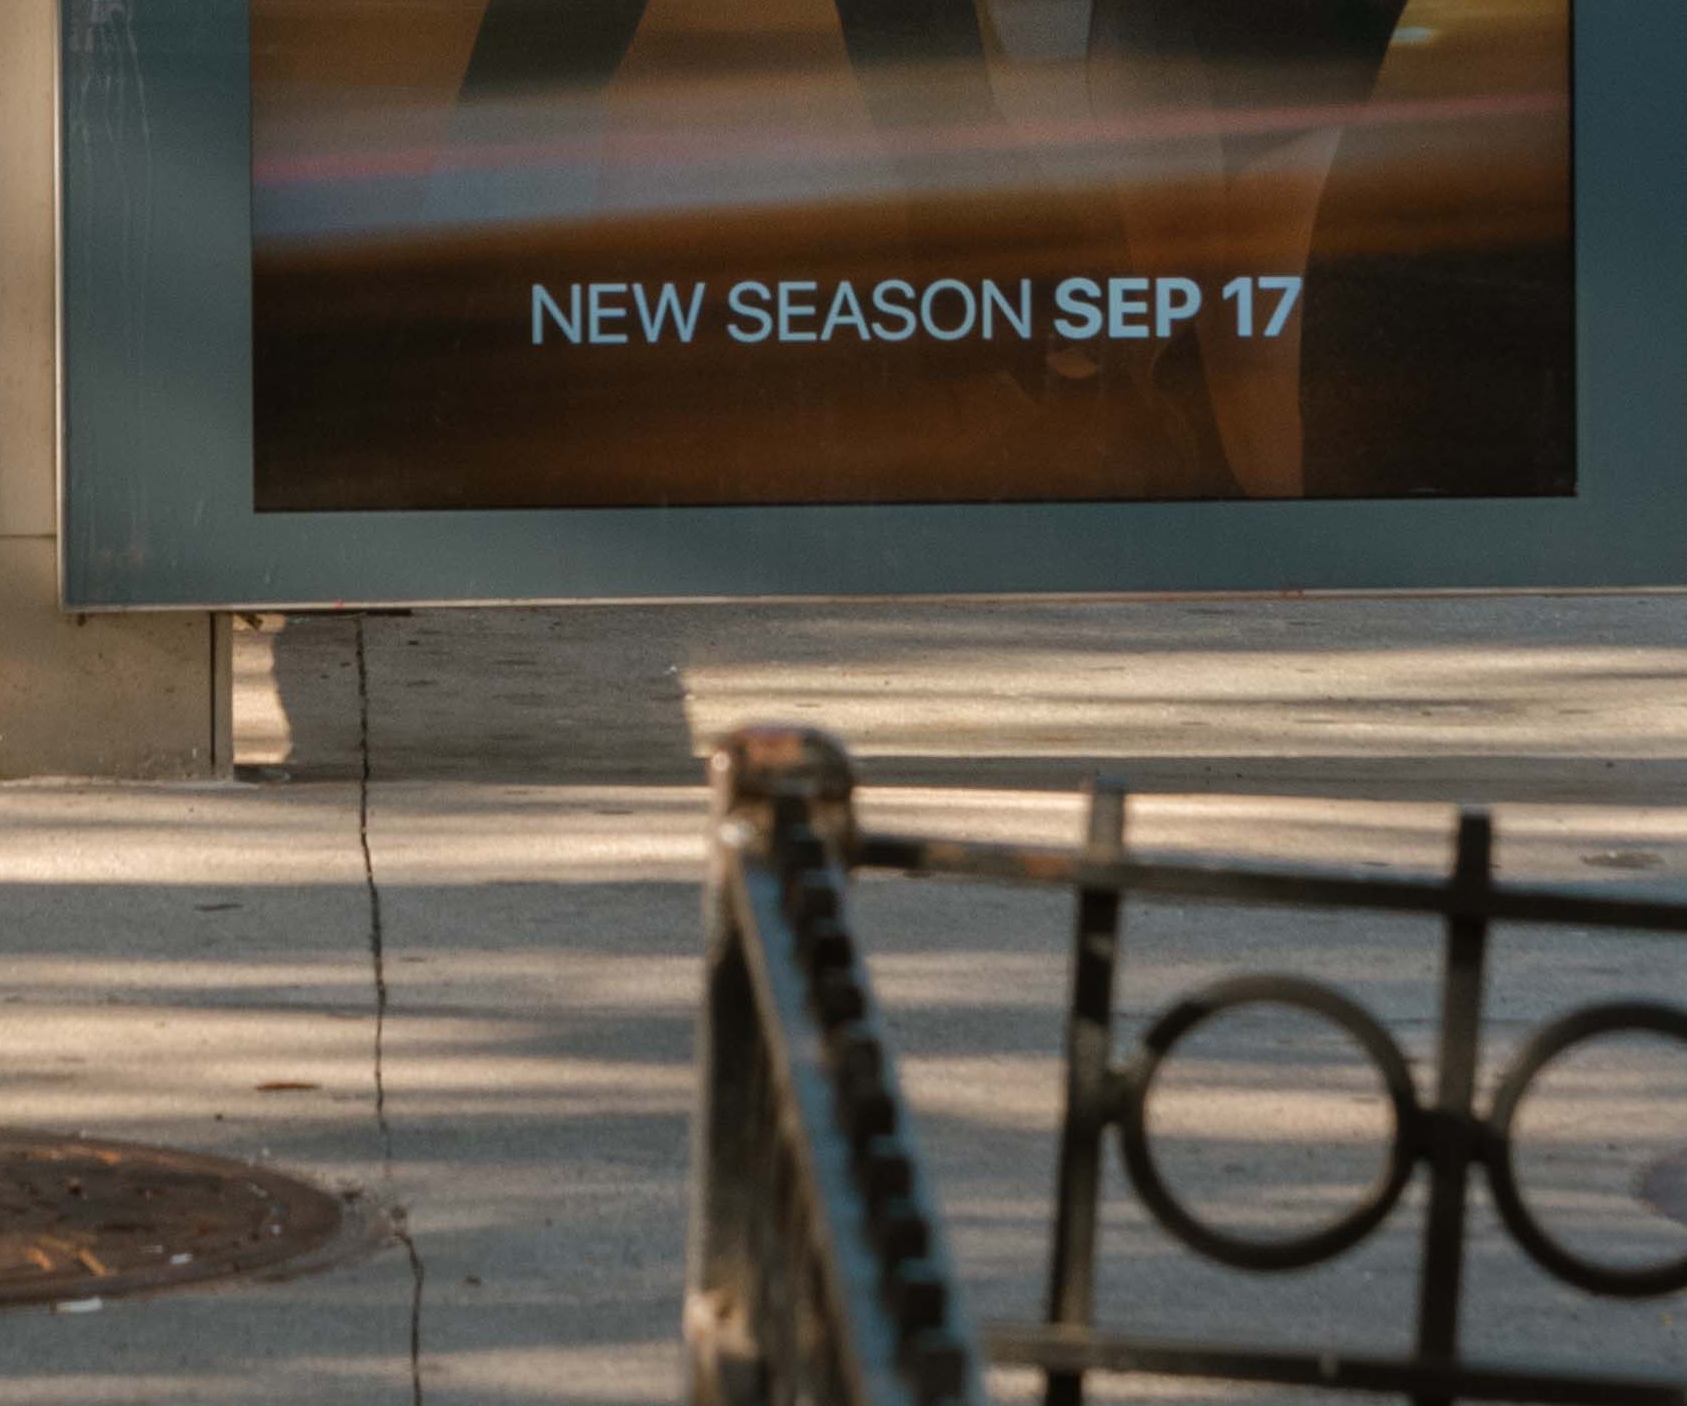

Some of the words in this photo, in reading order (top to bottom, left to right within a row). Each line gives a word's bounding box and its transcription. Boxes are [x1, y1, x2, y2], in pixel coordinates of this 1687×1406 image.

[531, 282, 706, 344] NEW
[726, 279, 1032, 343] SEASON
[1053, 277, 1202, 339] SEP
[1222, 276, 1303, 337] 17
